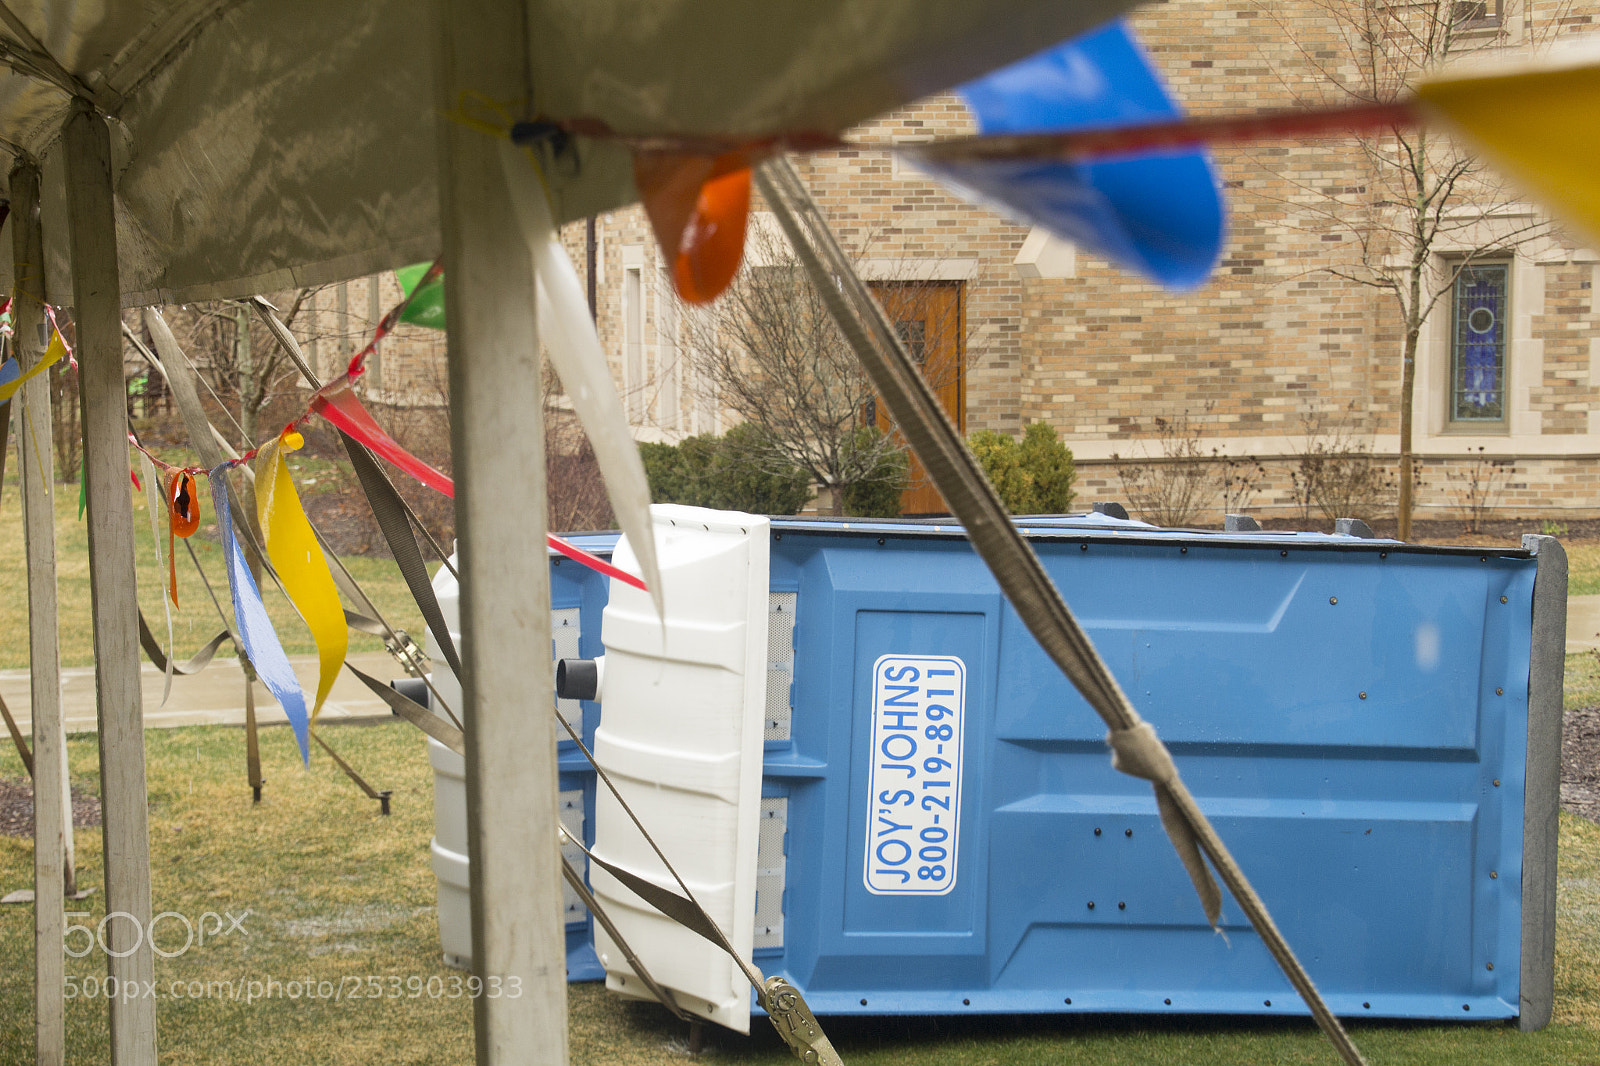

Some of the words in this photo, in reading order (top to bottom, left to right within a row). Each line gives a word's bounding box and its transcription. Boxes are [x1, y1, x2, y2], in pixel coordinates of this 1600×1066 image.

[881, 665, 921, 779] JOHNS
[917, 667, 955, 882] 800-219-8911
[875, 789, 915, 884] JOY'S
